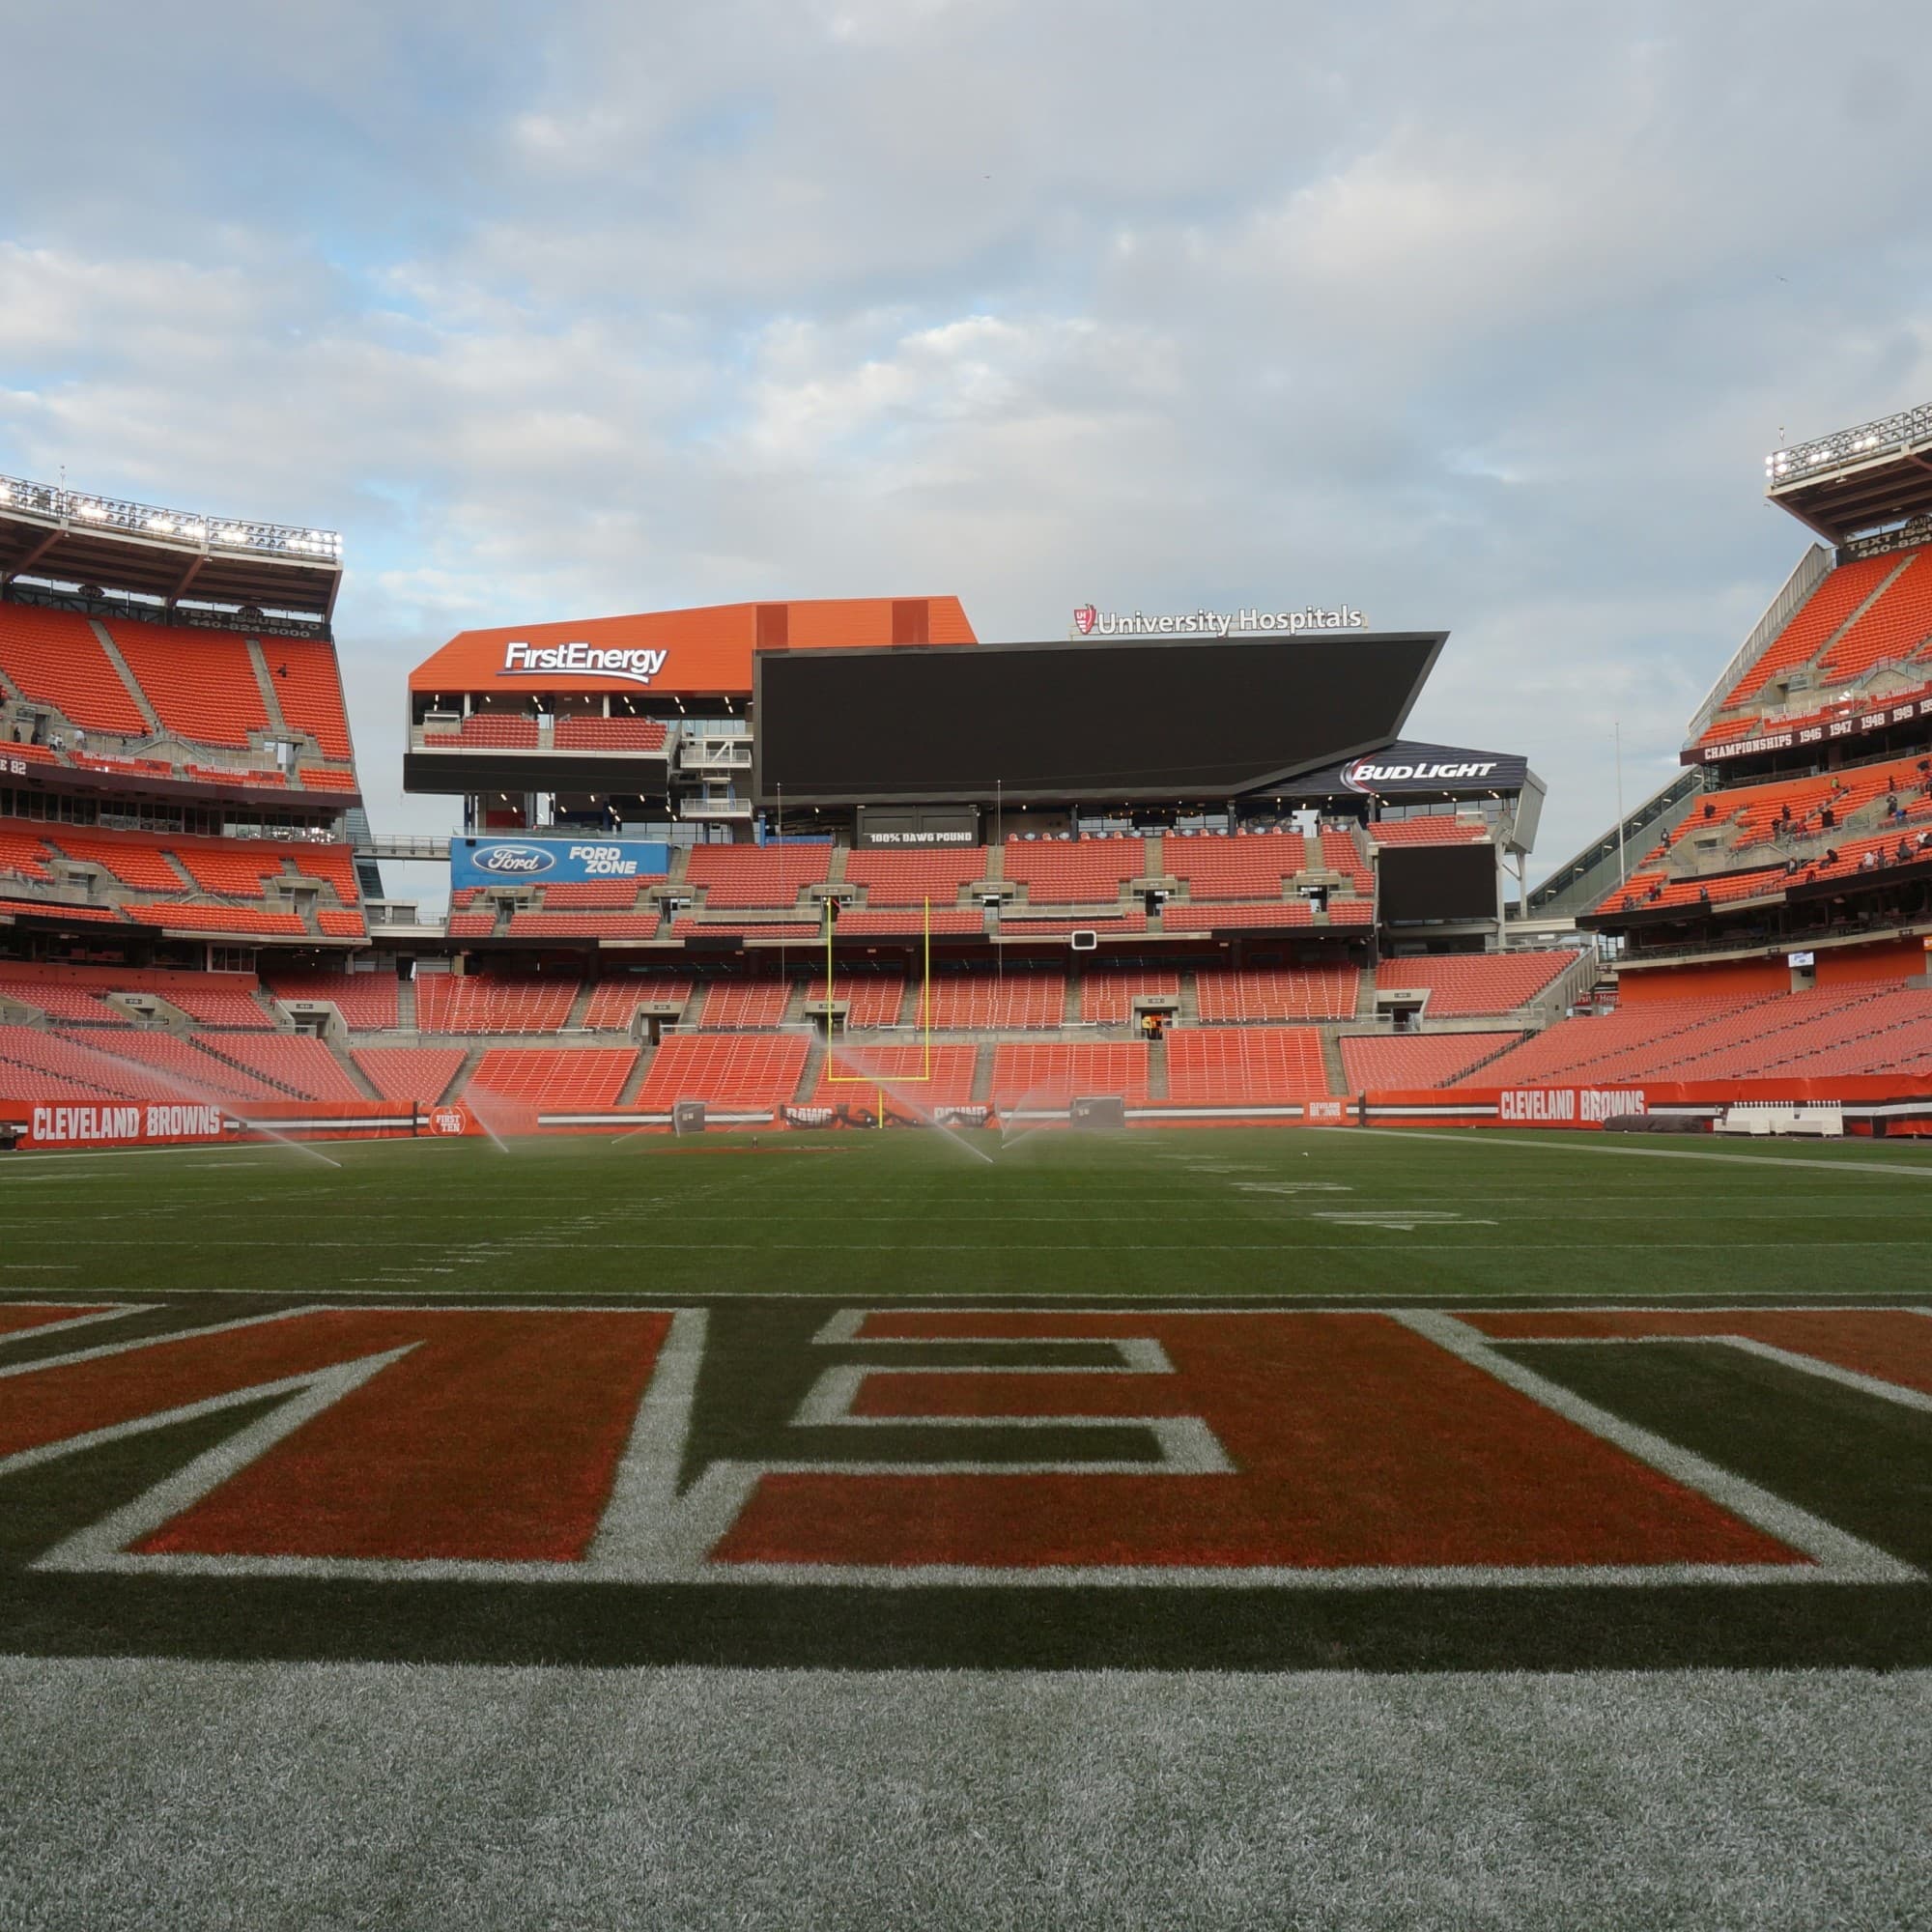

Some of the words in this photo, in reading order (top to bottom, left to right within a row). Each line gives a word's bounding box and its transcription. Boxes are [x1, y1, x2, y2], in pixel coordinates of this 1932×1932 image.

[1847, 533, 1893, 552] TEXT
[180, 609, 223, 621] TEXT
[298, 621, 321, 631] TO
[1098, 609, 1233, 638] University
[1238, 604, 1362, 636] Hospitals
[504, 642, 668, 674] FirstEnergy
[1704, 734, 1793, 760] CHAMPIONSHIPS
[1830, 721, 1853, 736] 1947
[1861, 713, 1885, 729] 1948
[1892, 705, 1914, 722] 1949
[870, 833, 900, 843] 100%
[902, 833, 935, 842] DAWG
[936, 832, 972, 841] POUND
[488, 847, 539, 870] Ford
[569, 846, 621, 861] FORD
[584, 860, 638, 874] ZONE
[1500, 1090, 1575, 1121] CLEVELAND
[1579, 1091, 1645, 1122] BROWNS
[33, 1107, 140, 1140] CLEVELAND
[146, 1105, 220, 1136] BROWNS
[440, 1122, 460, 1132] TEN
